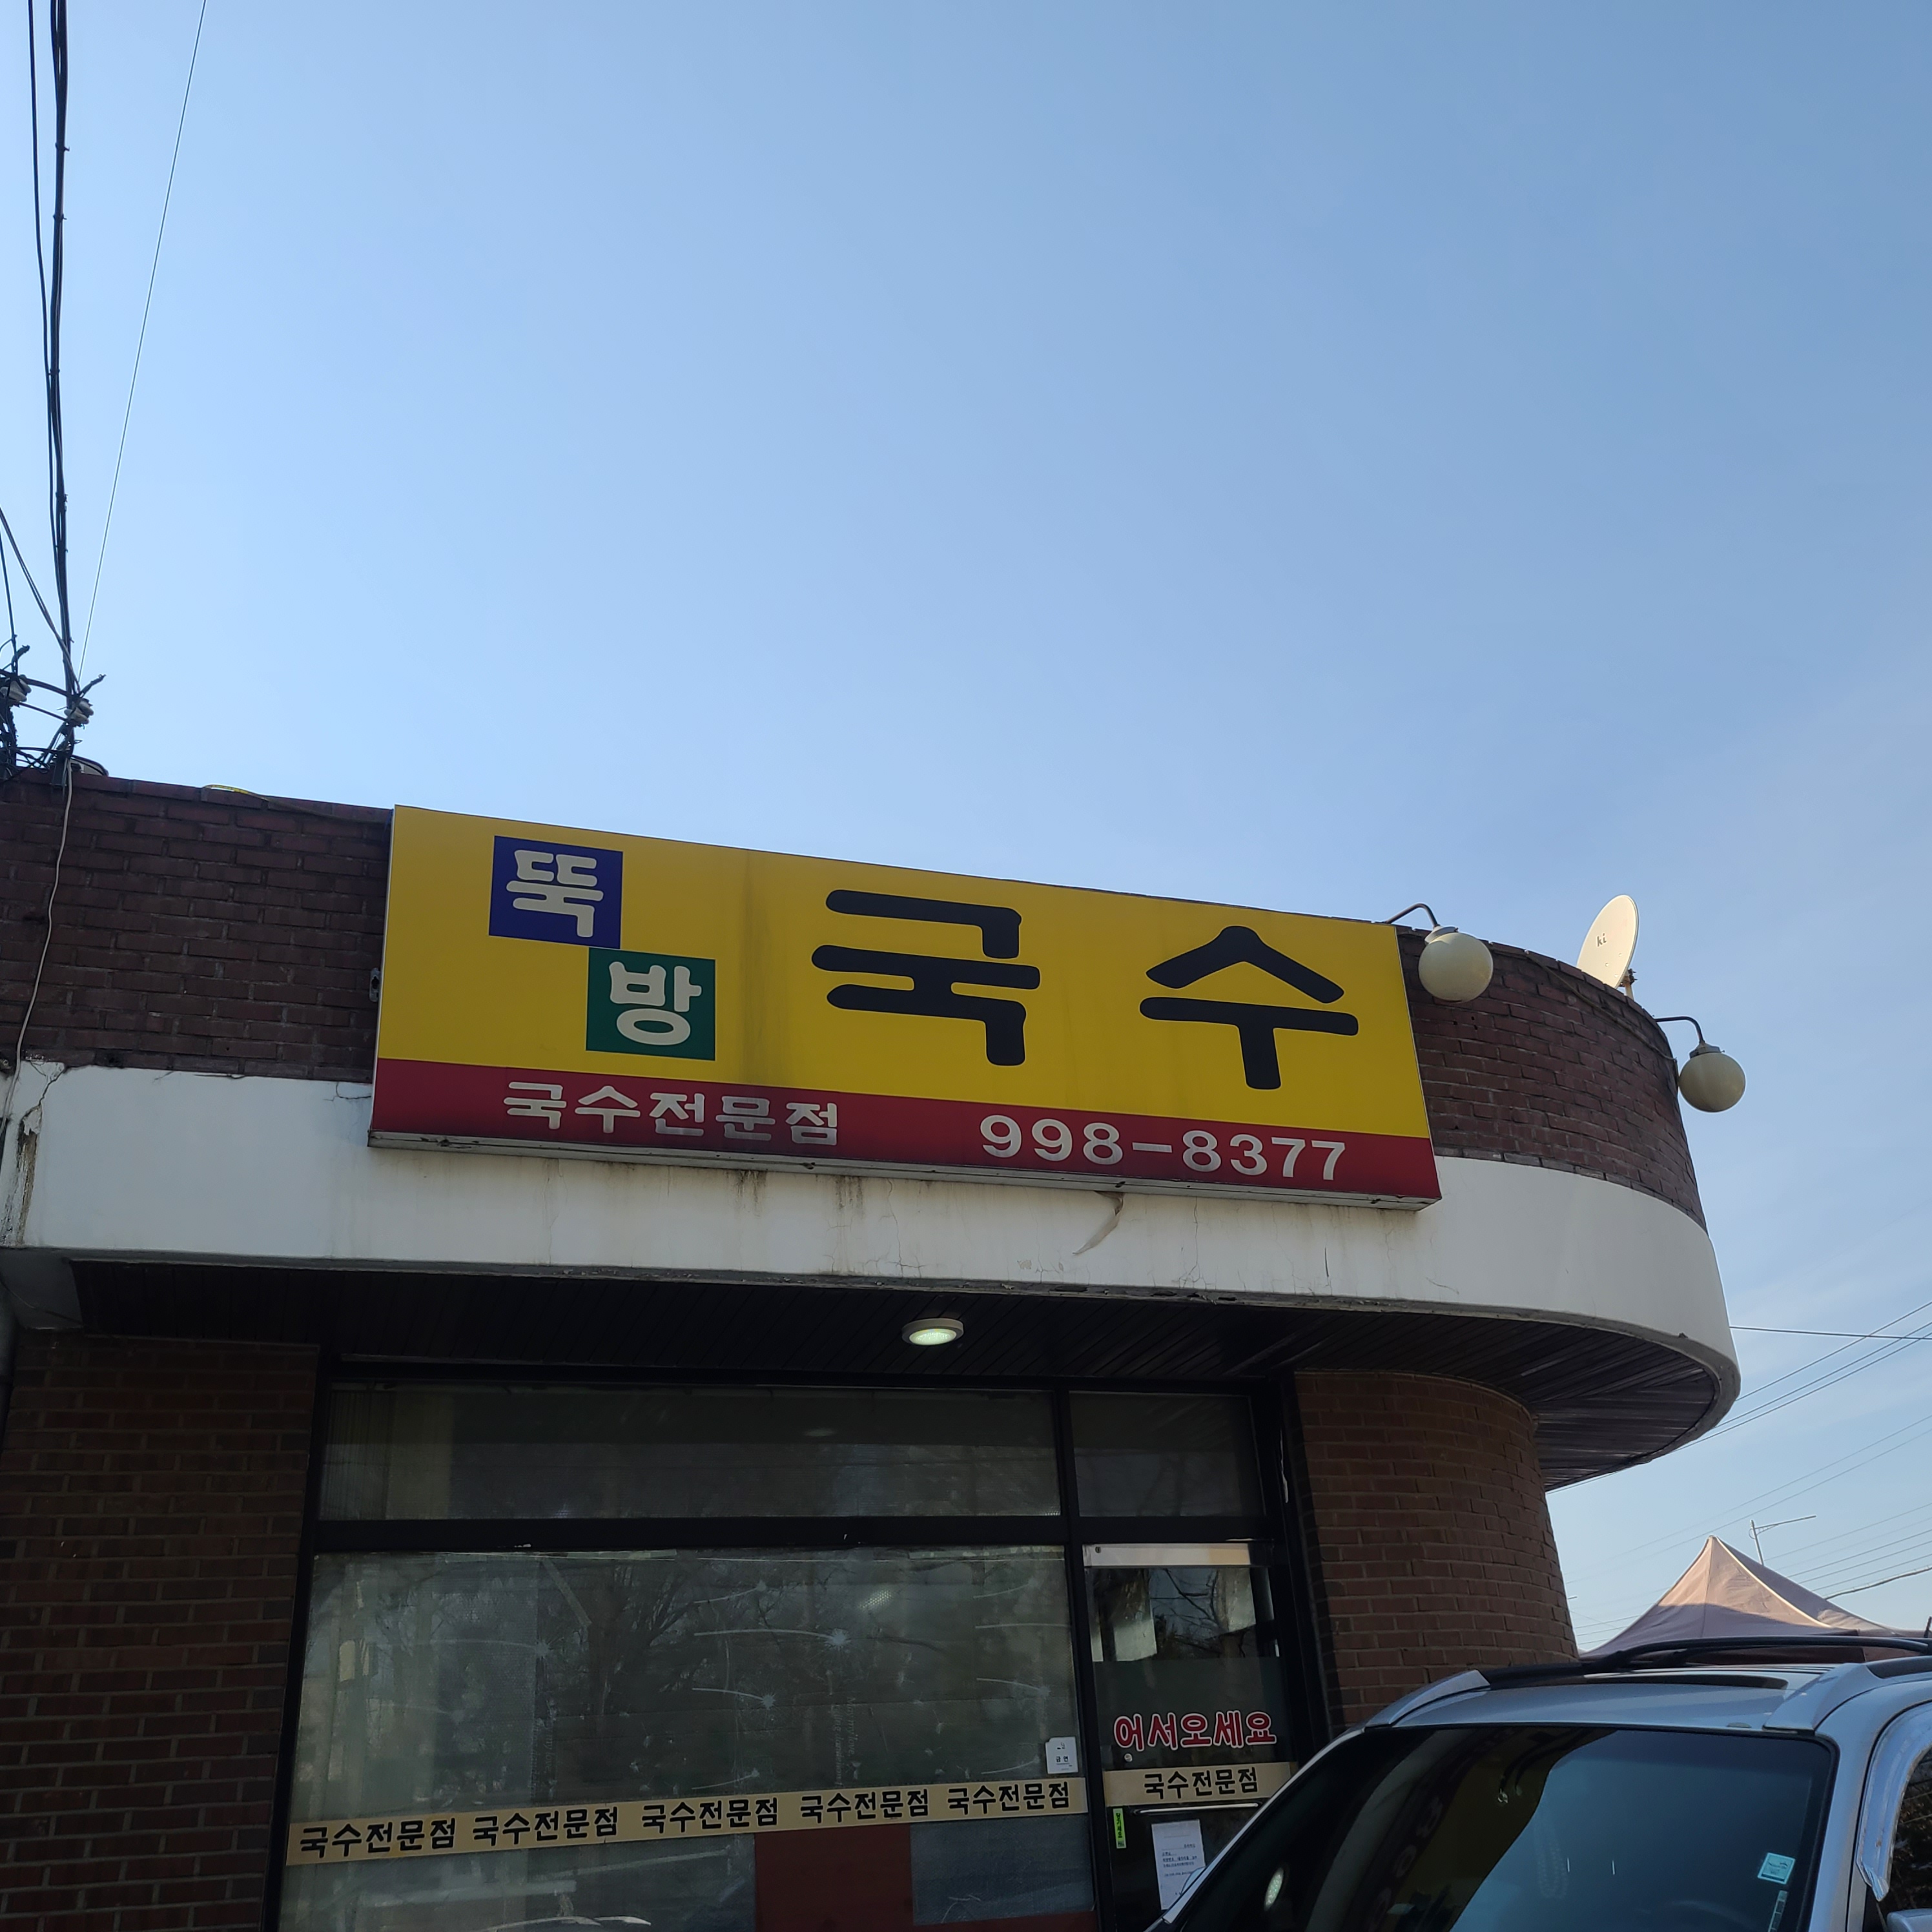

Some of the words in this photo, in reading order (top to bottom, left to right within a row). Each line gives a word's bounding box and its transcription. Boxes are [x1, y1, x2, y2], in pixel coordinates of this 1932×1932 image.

[812, 889, 1359, 1090] 국수
[504, 1082, 838, 1146] 국수전문점
[980, 1115, 1346, 1180] 998-8377
[1114, 1711, 1277, 1751] 어서오세요
[1144, 1767, 1259, 1799] 국수전문점
[300, 1818, 455, 1858] 국수전문점
[473, 1807, 618, 1846] 국수전문점
[642, 1797, 778, 1833] 국수전문점
[801, 1789, 929, 1824] 국수전문점
[947, 1782, 1069, 1815] 국수전문점
